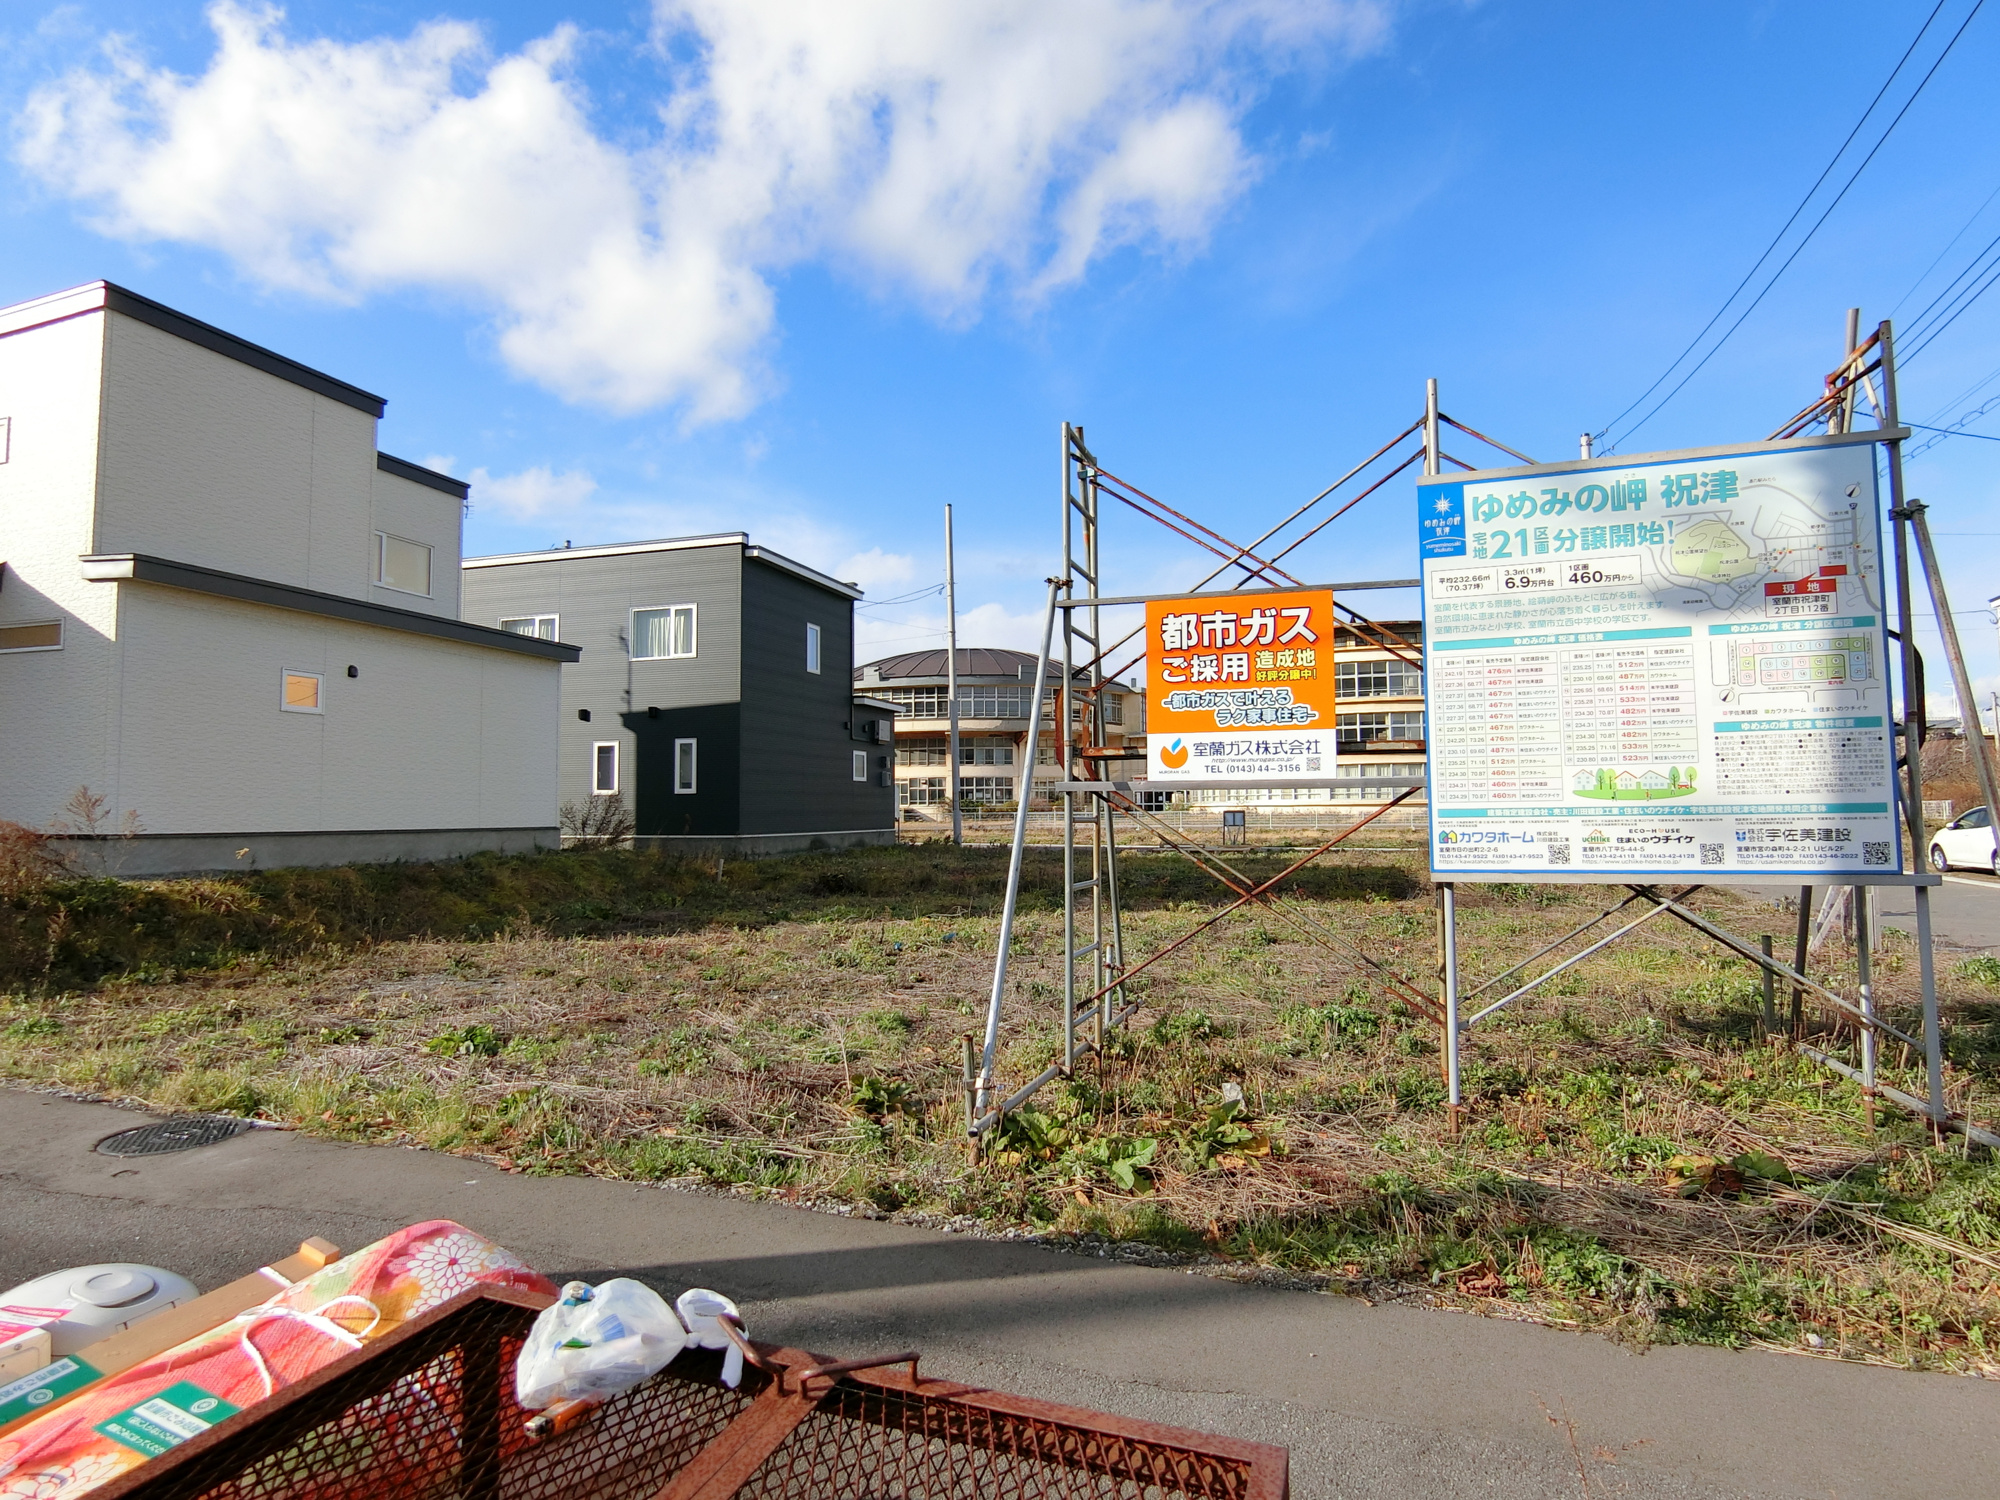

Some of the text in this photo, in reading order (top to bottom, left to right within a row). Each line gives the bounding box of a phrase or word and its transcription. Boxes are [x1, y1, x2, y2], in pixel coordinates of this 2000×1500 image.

[1472, 469, 1739, 523] ゆめみの岬 祝津
[1568, 564, 1589, 572] 1区画
[1505, 576, 1555, 589] 6.9万円台
[1568, 570, 1634, 584] 460万円から
[1445, 584, 1484, 592] (70.37坪)
[1782, 582, 1820, 593] 現地
[1772, 594, 1830, 606] 室蘭市祝津町
[1774, 604, 1828, 614] 2丁目112番
[1161, 607, 1318, 651] 都市ガス
[1254, 648, 1316, 669] 造成地
[1162, 653, 1249, 683] ご採用
[1256, 668, 1317, 682] 好評分譲中!
[1818, 705, 1868, 713] 住まいのウチイケ
[1193, 739, 1322, 757] 室蘭ガス株式会社
[1204, 765, 1223, 773] TEL
[1459, 832, 1534, 843] カワタホーム
[1616, 836, 1695, 844] 住まいのウチイケ
